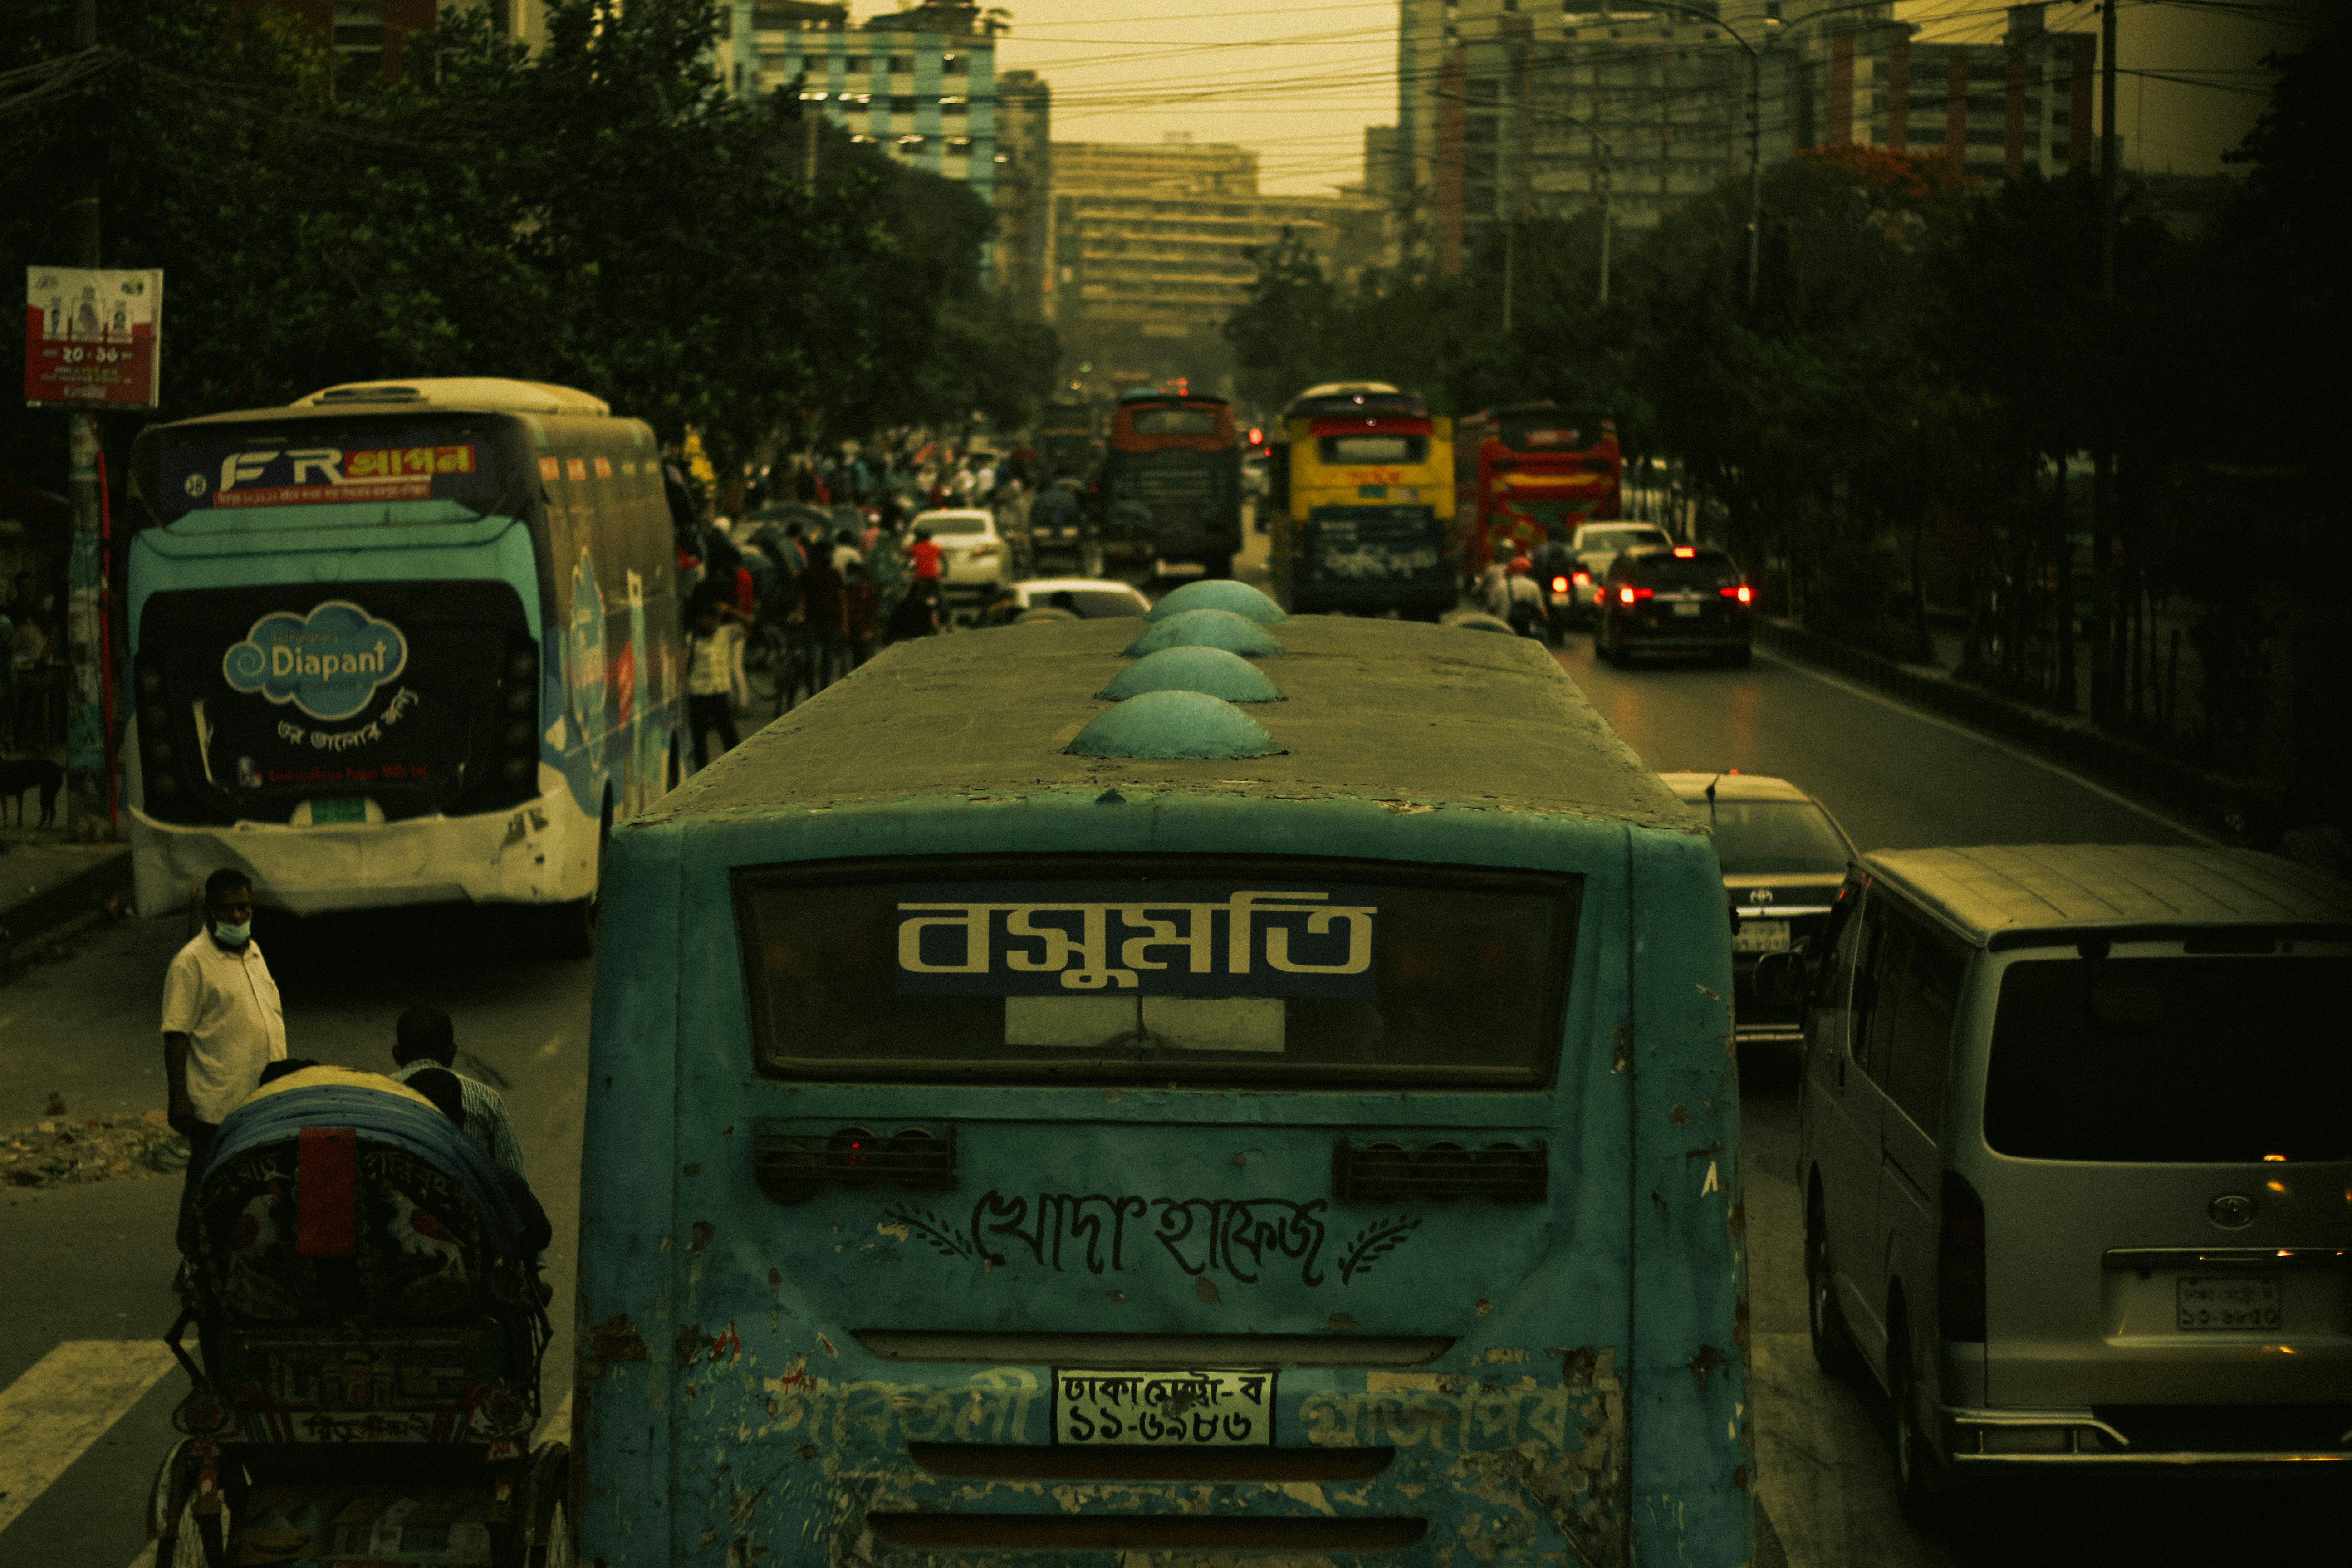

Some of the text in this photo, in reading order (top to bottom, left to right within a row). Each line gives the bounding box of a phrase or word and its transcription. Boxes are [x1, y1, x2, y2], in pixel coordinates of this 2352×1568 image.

[272, 639, 387, 681] Diapant
[897, 890, 1378, 989] বসুমতি
[971, 1190, 1328, 1286] খোদা হাফেজ
[1061, 1377, 1144, 1406] ঢাকা
